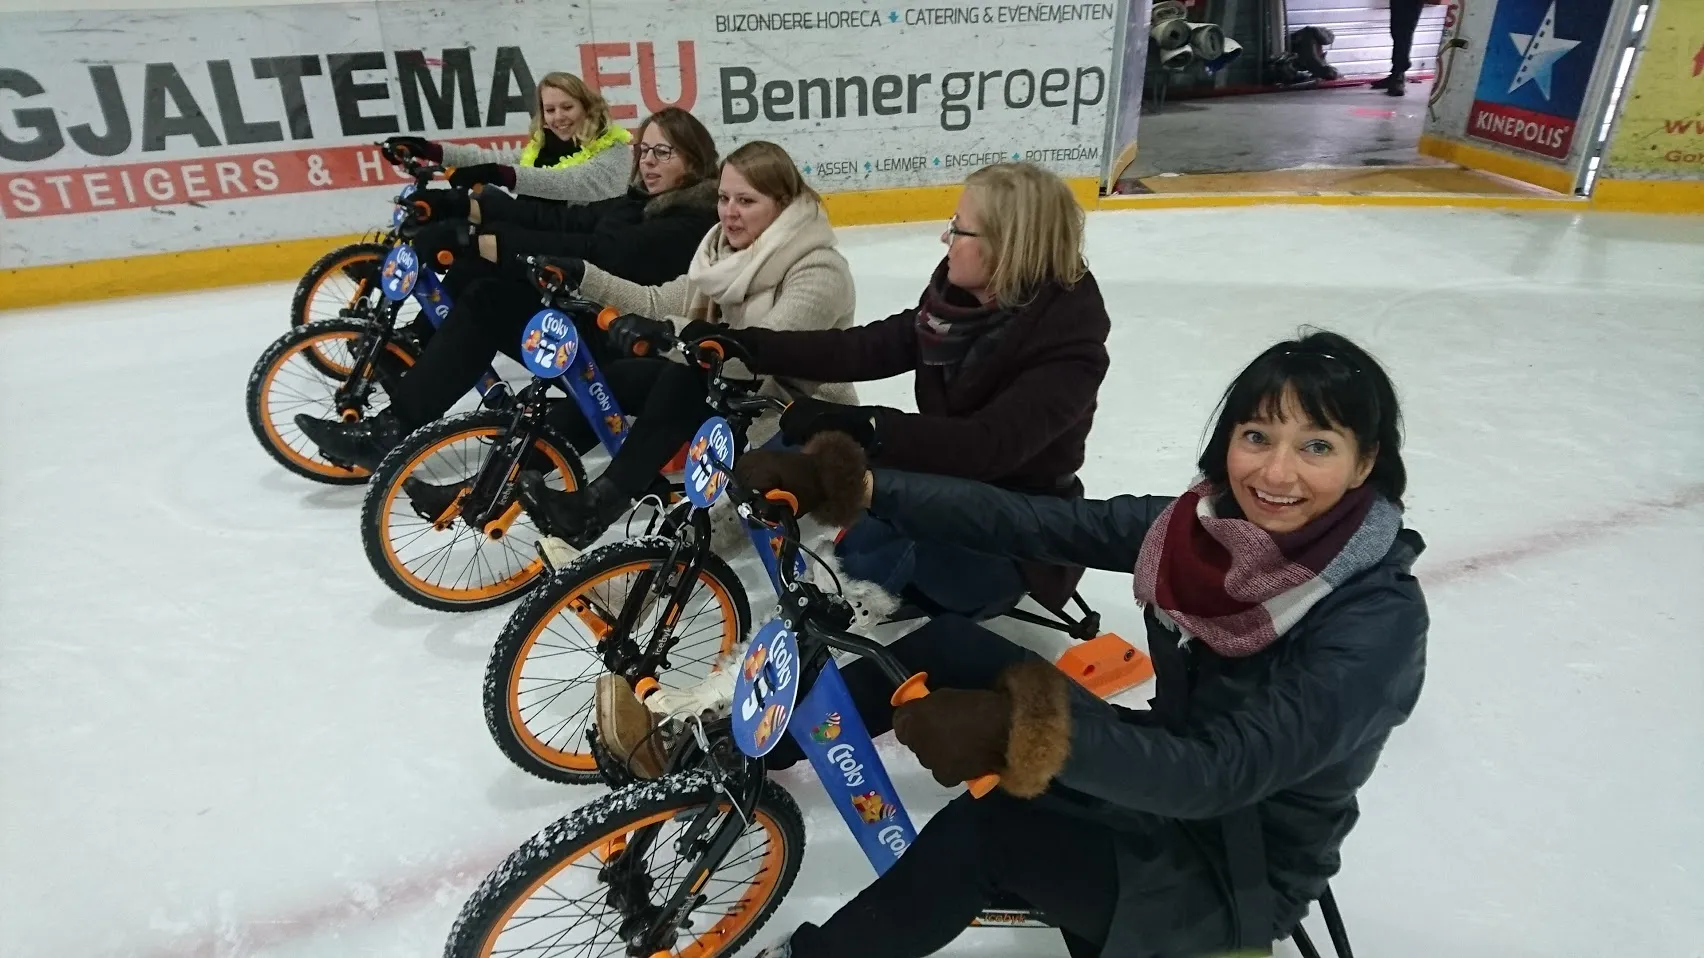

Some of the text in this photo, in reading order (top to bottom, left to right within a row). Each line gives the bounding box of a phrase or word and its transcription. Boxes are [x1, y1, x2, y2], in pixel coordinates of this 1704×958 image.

[715, 4, 1114, 33] BIJZONDERE HORECA CATERING & EVENEMENTEN
[0, 46, 537, 162] GJALTEMA
[818, 160, 858, 176] ASSEN
[876, 156, 927, 172] LEMMER
[945, 151, 1007, 167] ENSCHEDE
[8, 158, 280, 213] STEIGERS
[306, 154, 334, 189] &
[541, 312, 569, 339] Croky
[534, 339, 557, 369] 12
[588, 382, 612, 411] Croky
[708, 423, 729, 462] Croky
[769, 630, 791, 690] Croky
[827, 743, 865, 788] Croky
[878, 825, 911, 859] Crok
